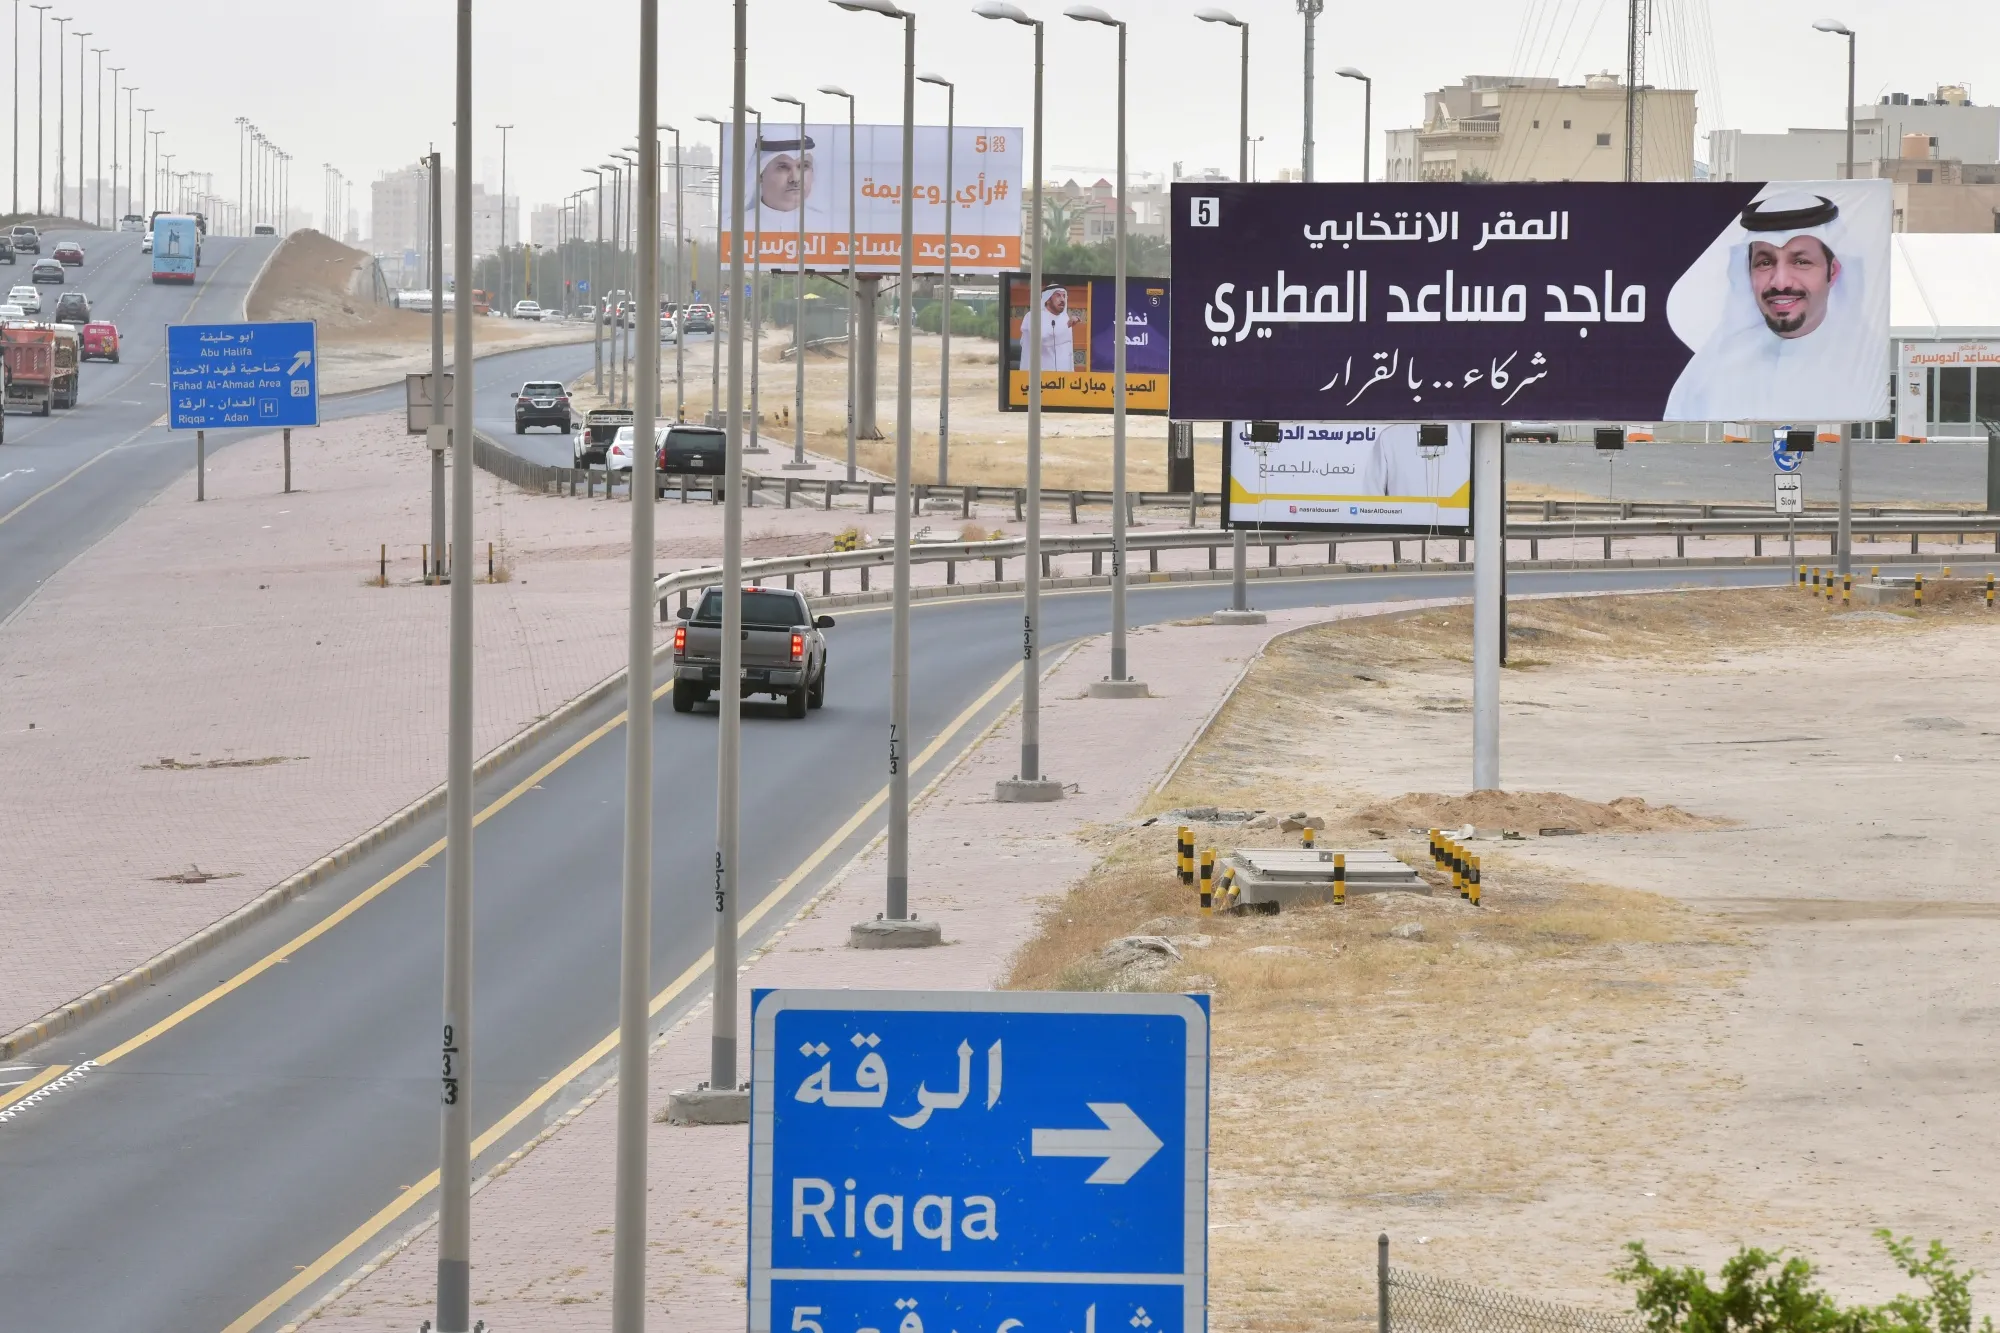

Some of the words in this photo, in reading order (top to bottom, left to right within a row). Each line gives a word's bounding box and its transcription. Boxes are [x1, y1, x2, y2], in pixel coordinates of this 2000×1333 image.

[976, 135, 988, 153] 5
[993, 135, 1005, 144] 20
[1198, 199, 1210, 225] 5
[1303, 211, 1459, 250] الانتخابي
[1473, 210, 1569, 251] المقر
[919, 242, 980, 260] محمد
[988, 243, 1006, 258] د.
[1386, 269, 1527, 322] مساعد
[1544, 269, 1646, 339] ماجد
[1204, 269, 1367, 347] المطيري
[199, 331, 235, 344] حليفة
[239, 330, 254, 343] ابو
[200, 348, 220, 357] Abu
[223, 347, 252, 357] Halifa
[213, 362, 236, 376] فهد
[240, 362, 281, 374] ضاحية
[1319, 348, 1423, 406] بالقرار
[172, 382, 203, 391] Fahad
[206, 379, 255, 390] Al-Ahmad
[258, 379, 281, 388] Area
[1070, 377, 1107, 395] مبارك
[1463, 350, 1548, 406] شركاء
[293, 386, 307, 395] 211
[178, 397, 206, 411] الرقة
[217, 397, 256, 410] العدان
[178, 415, 205, 424] Riqqa
[224, 414, 249, 422] Adan
[1307, 428, 1343, 442] سعد
[1345, 426, 1376, 445] ناصر
[1780, 496, 1797, 506] Slow
[794, 1032, 1003, 1130] الرقة
[791, 1177, 1000, 1252] Riqqa
